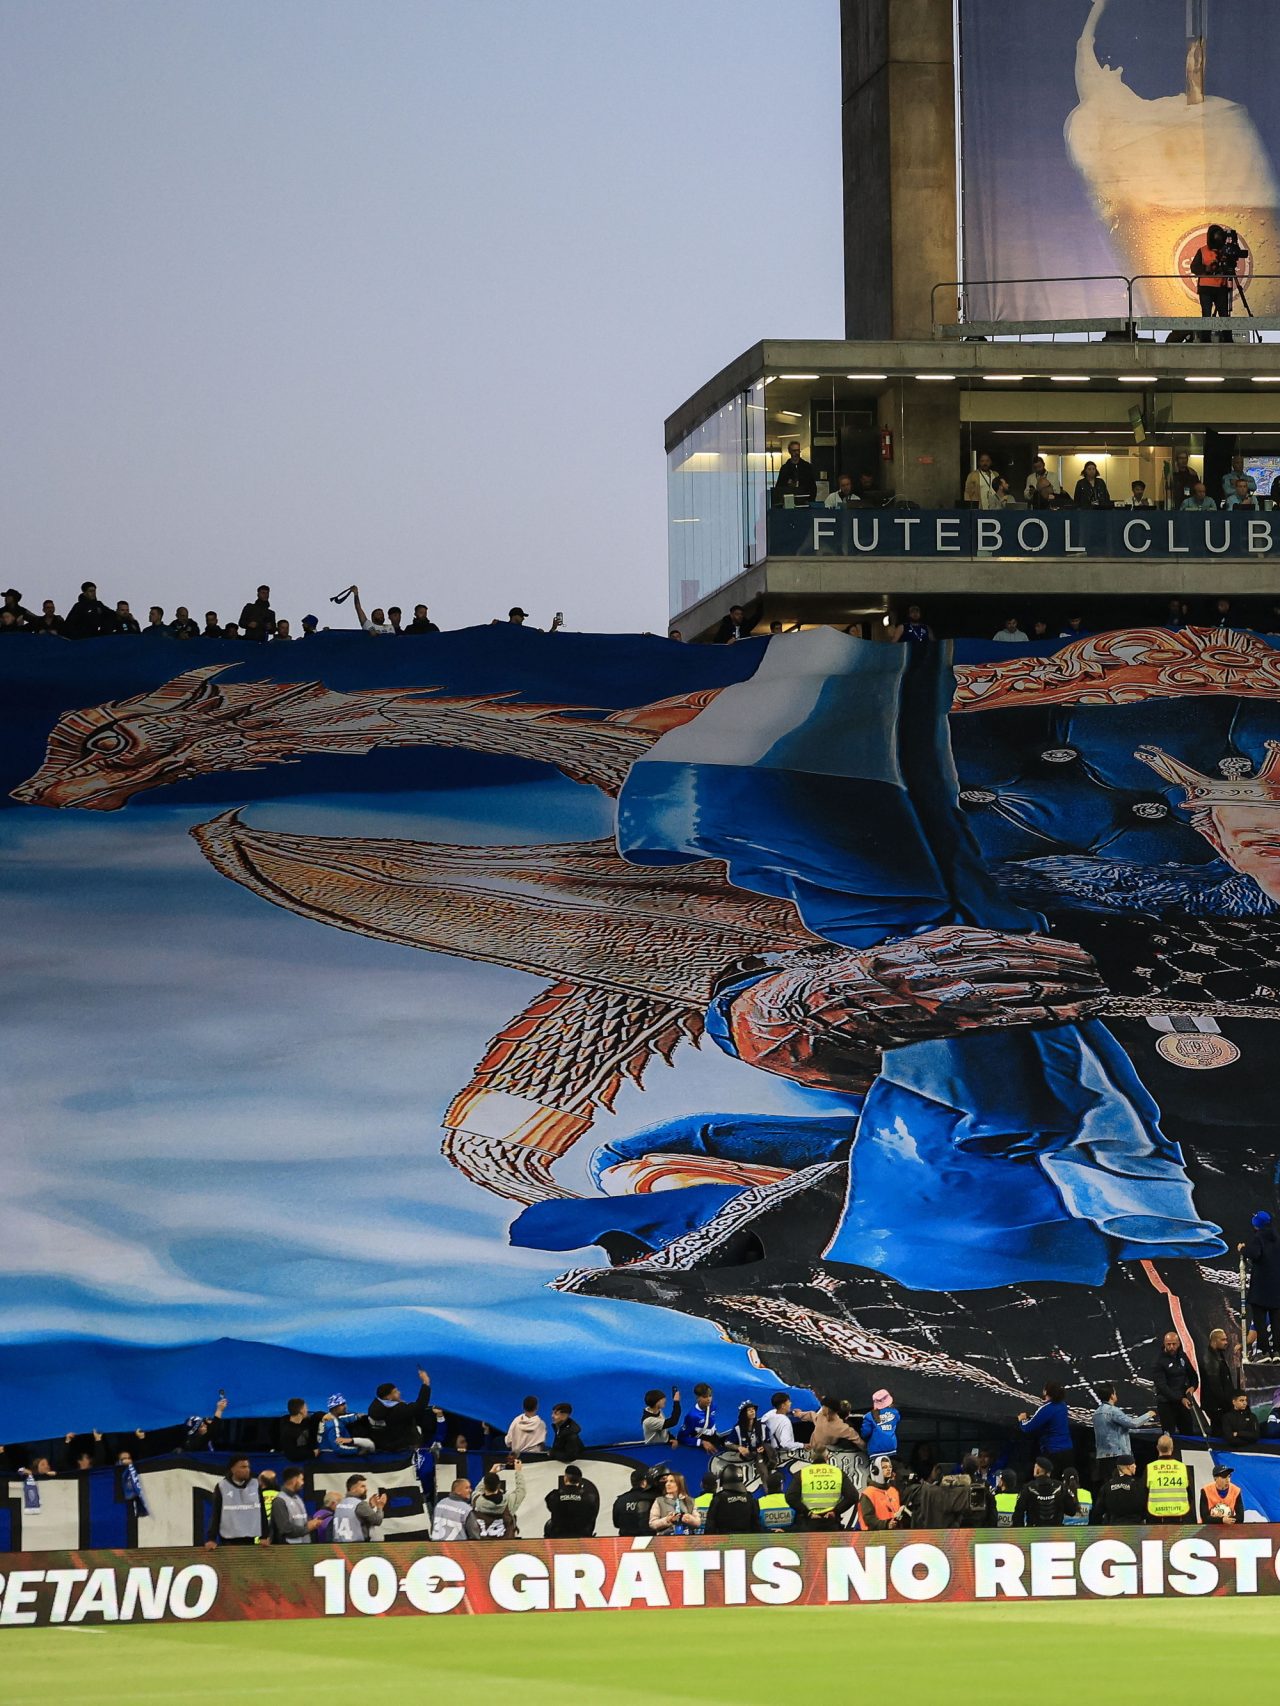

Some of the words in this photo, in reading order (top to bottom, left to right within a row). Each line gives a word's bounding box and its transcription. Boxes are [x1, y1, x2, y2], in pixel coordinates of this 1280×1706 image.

[812, 517, 1086, 553] FUTEBOL
[810, 1480, 837, 1491] 1332
[1157, 1476, 1183, 1487] 1244
[431, 1516, 463, 1541] 37
[0, 1563, 219, 1625] ETANO
[313, 1555, 466, 1616] 10€
[488, 1536, 803, 1613] GRÁTIS
[826, 1542, 951, 1602] NO
